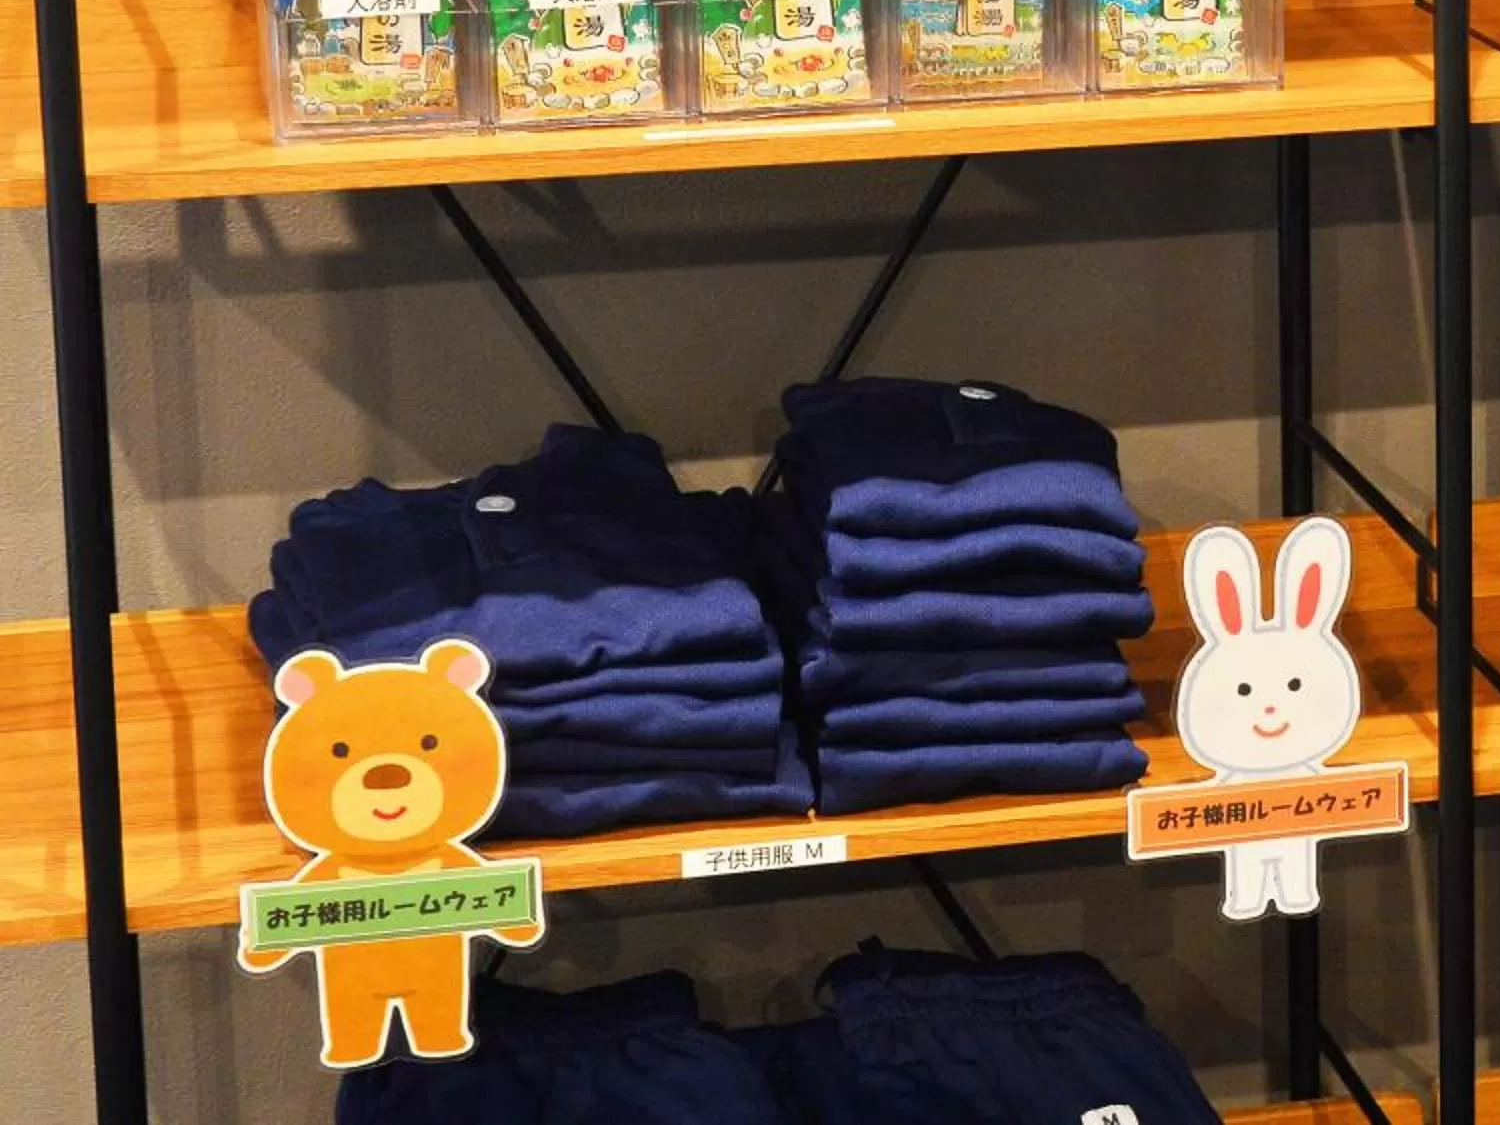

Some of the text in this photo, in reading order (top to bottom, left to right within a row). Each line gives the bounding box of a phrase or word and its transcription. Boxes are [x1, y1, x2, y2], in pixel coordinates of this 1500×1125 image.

[1157, 787, 1381, 830] お子様用ルームウェア
[704, 841, 824, 872] 子供用服 M
[265, 885, 518, 929] お子様用ルームウェア
